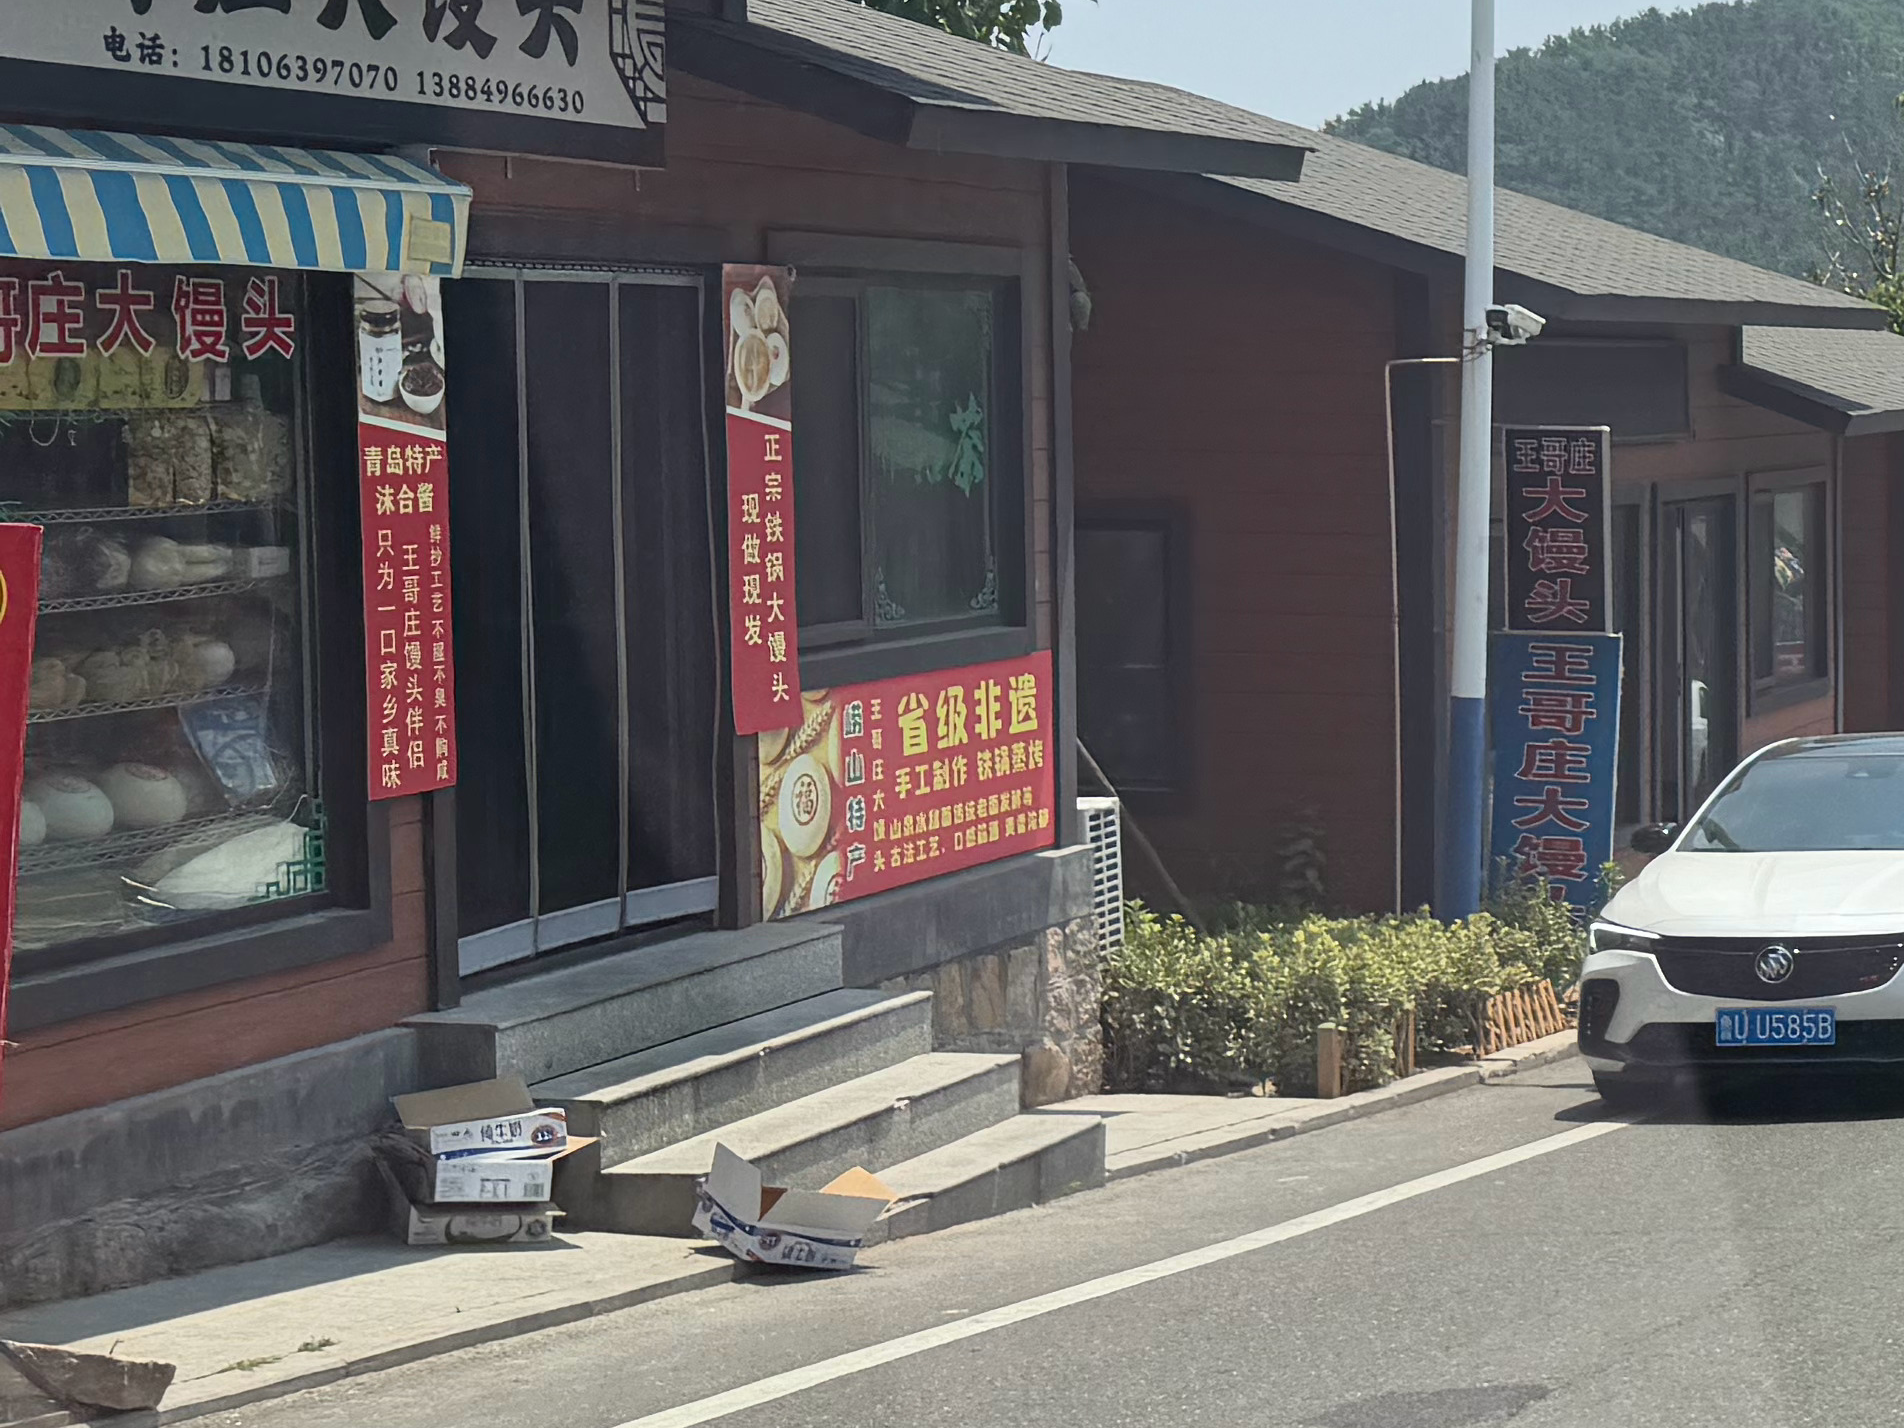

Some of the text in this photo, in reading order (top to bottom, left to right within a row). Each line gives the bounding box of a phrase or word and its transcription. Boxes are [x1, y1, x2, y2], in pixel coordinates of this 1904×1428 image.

[200, 44, 398, 93] 18106397070
[416, 70, 585, 114] 13884966630
[364, 444, 442, 476] 青岛特产
[1513, 437, 1596, 475] 王哥庄
[741, 493, 762, 645] 现做现发
[764, 434, 790, 702] 正宗铁锅大馒头
[1521, 477, 1591, 624] 大馒头
[377, 529, 401, 788] 只为一口家乡真味
[402, 544, 424, 768] 王哥庄馒头伴侣
[897, 672, 1038, 757] 省级非遗
[843, 700, 867, 881] 崂山特产
[895, 755, 968, 799] 手工制作
